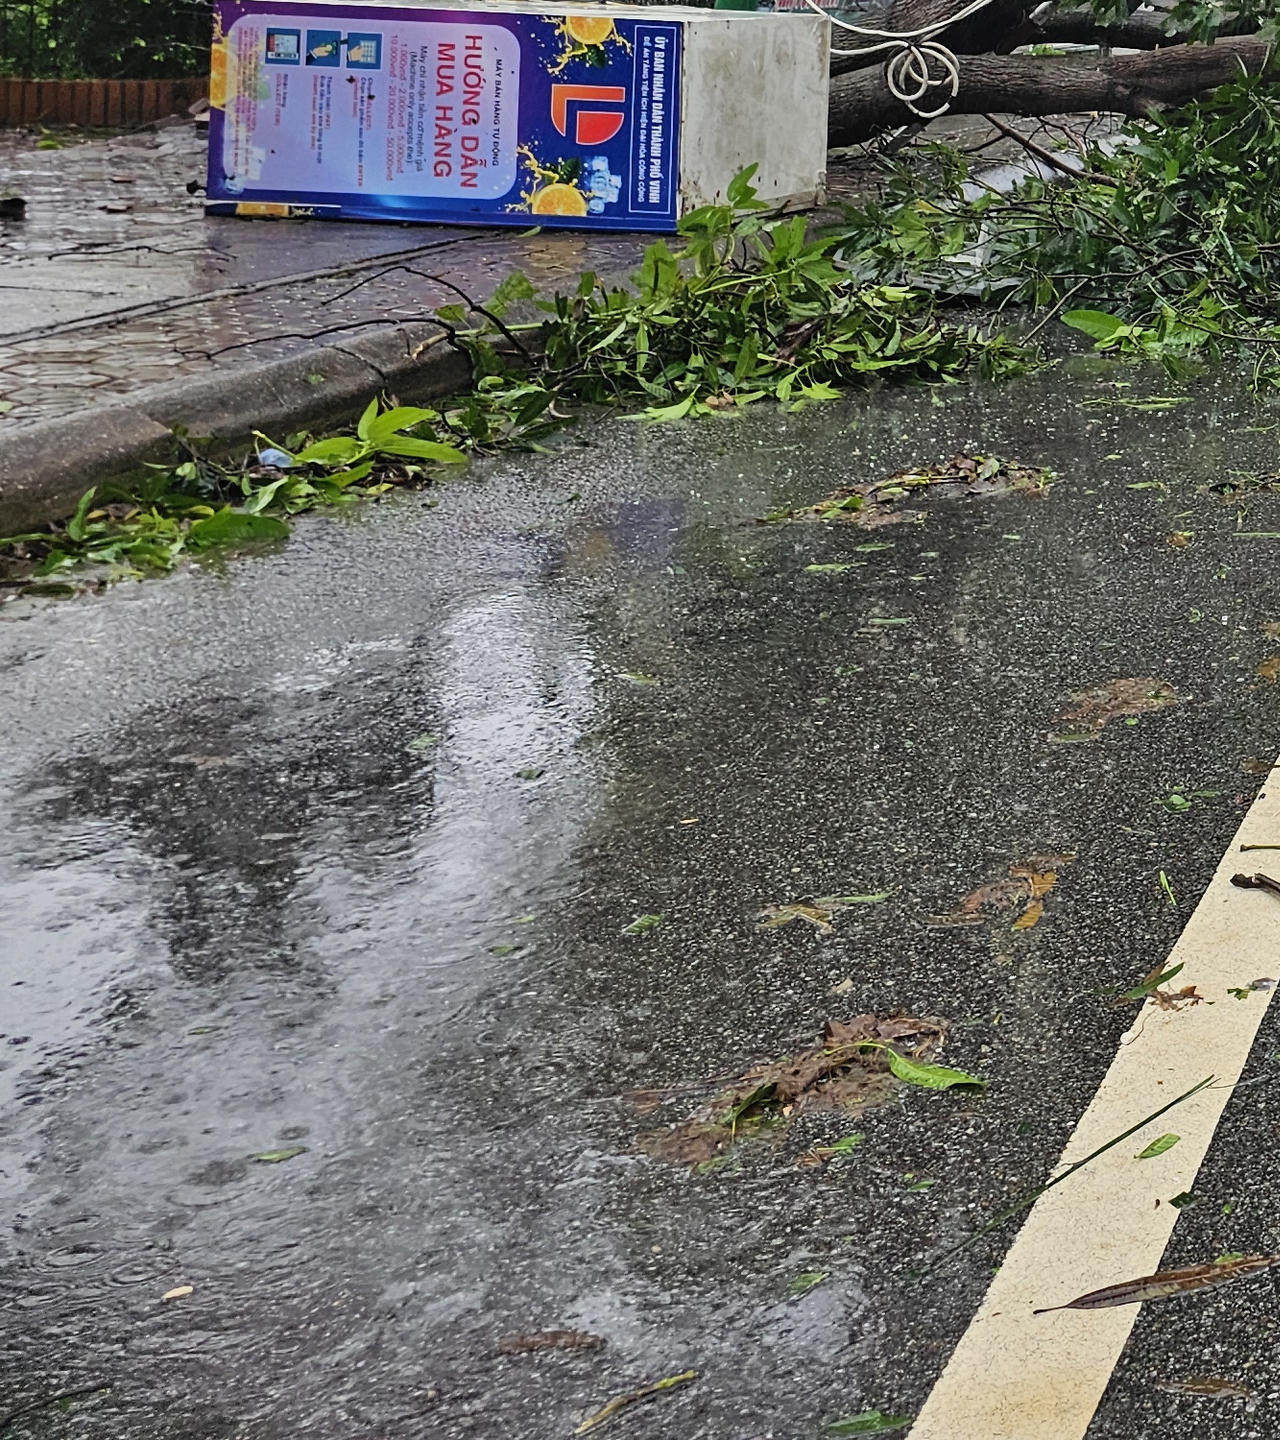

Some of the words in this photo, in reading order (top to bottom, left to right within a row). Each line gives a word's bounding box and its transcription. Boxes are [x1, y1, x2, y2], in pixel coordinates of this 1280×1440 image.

[654, 36, 668, 49] ỦY
[419, 46, 428, 64] Máy
[654, 51, 664, 71] BAN
[436, 43, 455, 97] MUA
[462, 35, 486, 126] HƯỚNG
[494, 80, 502, 97] BÁN
[653, 74, 666, 100] NHÂN
[408, 92, 416, 109] only
[493, 100, 501, 125] HÀNG
[652, 103, 664, 123] DÂN
[433, 106, 458, 177] HÀNG
[492, 128, 500, 138] TỰ
[650, 126, 664, 156] THÀNH
[460, 136, 487, 188] DẪN
[491, 141, 500, 166] ĐỘNG
[650, 158, 664, 179] PHỐ
[649, 180, 660, 203] VINH
